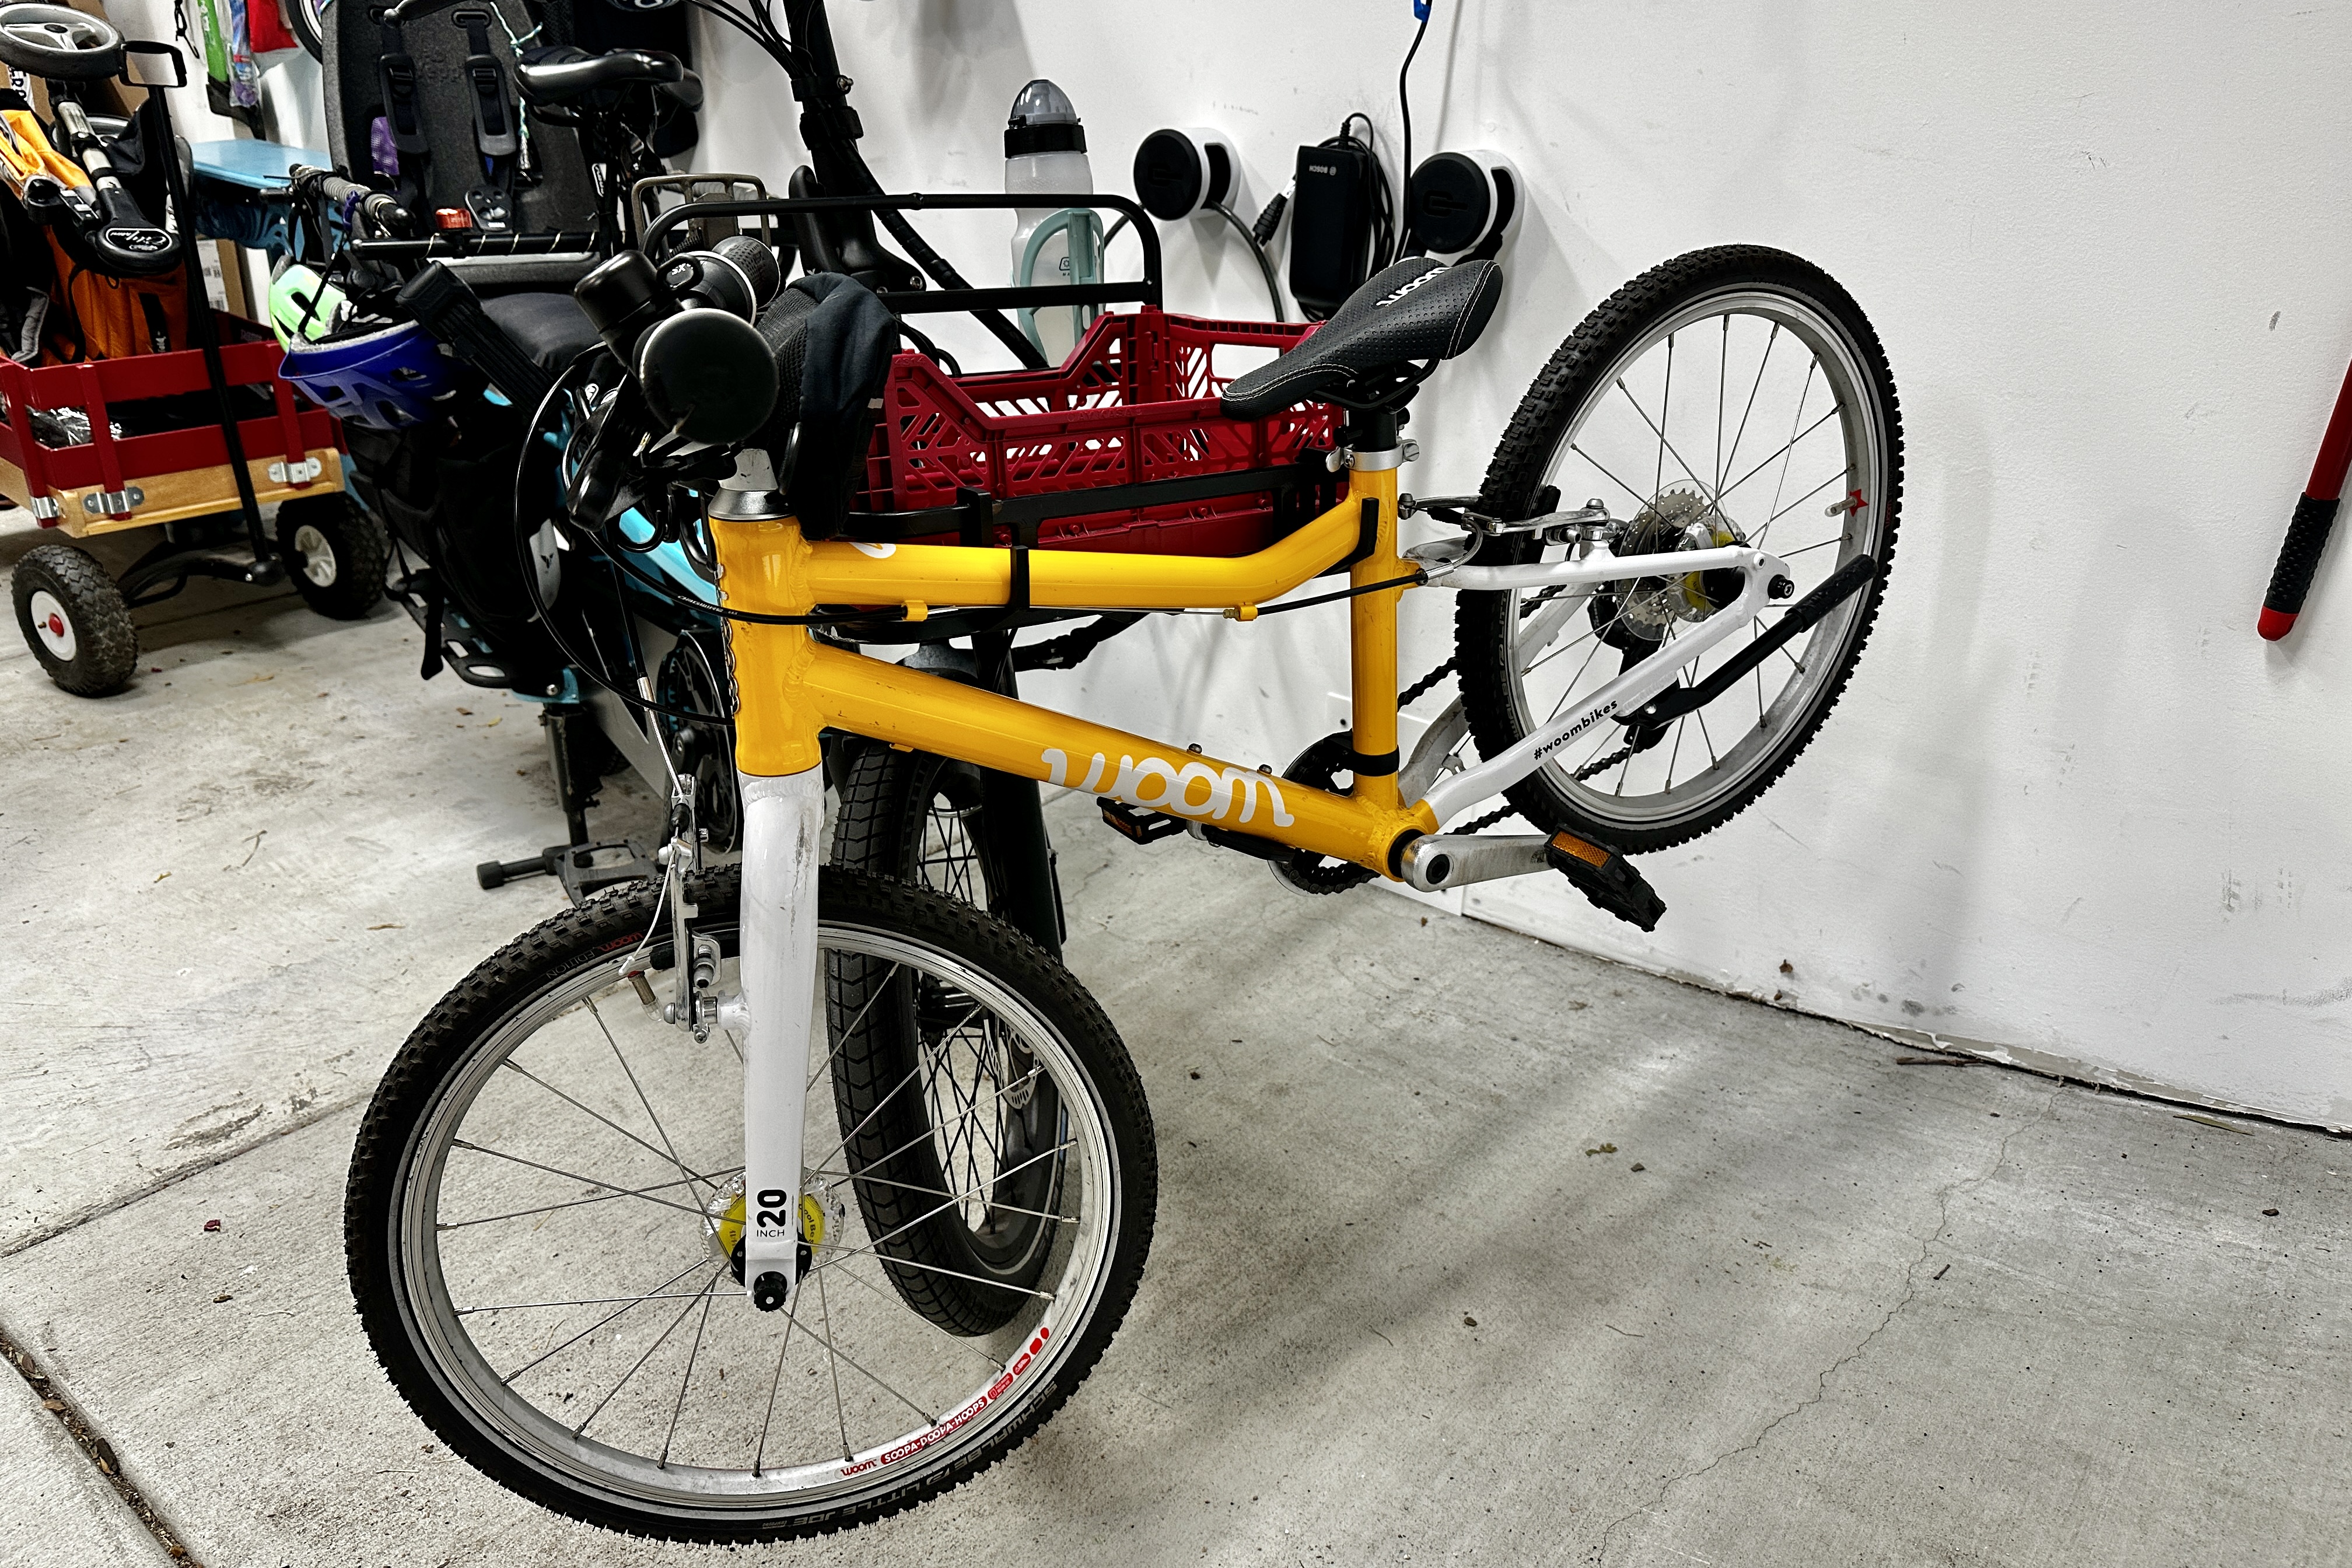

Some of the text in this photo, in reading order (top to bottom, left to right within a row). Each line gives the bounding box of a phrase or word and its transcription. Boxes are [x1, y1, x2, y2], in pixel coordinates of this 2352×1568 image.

[1375, 264, 1452, 307] woom
[1533, 699, 1618, 761] #woombikes
[1041, 748, 1294, 827] woom
[545, 950, 595, 979] EDITION
[757, 1189, 787, 1227] 20
[756, 1228, 785, 1237] INCH
[841, 1398, 985, 1476] woom SOOPA-DOOPA-HOOPS
[953, 1380, 1058, 1468] SCHWALBE
[792, 1510, 836, 1527] JOE
[841, 1482, 920, 1517] LITTLE
